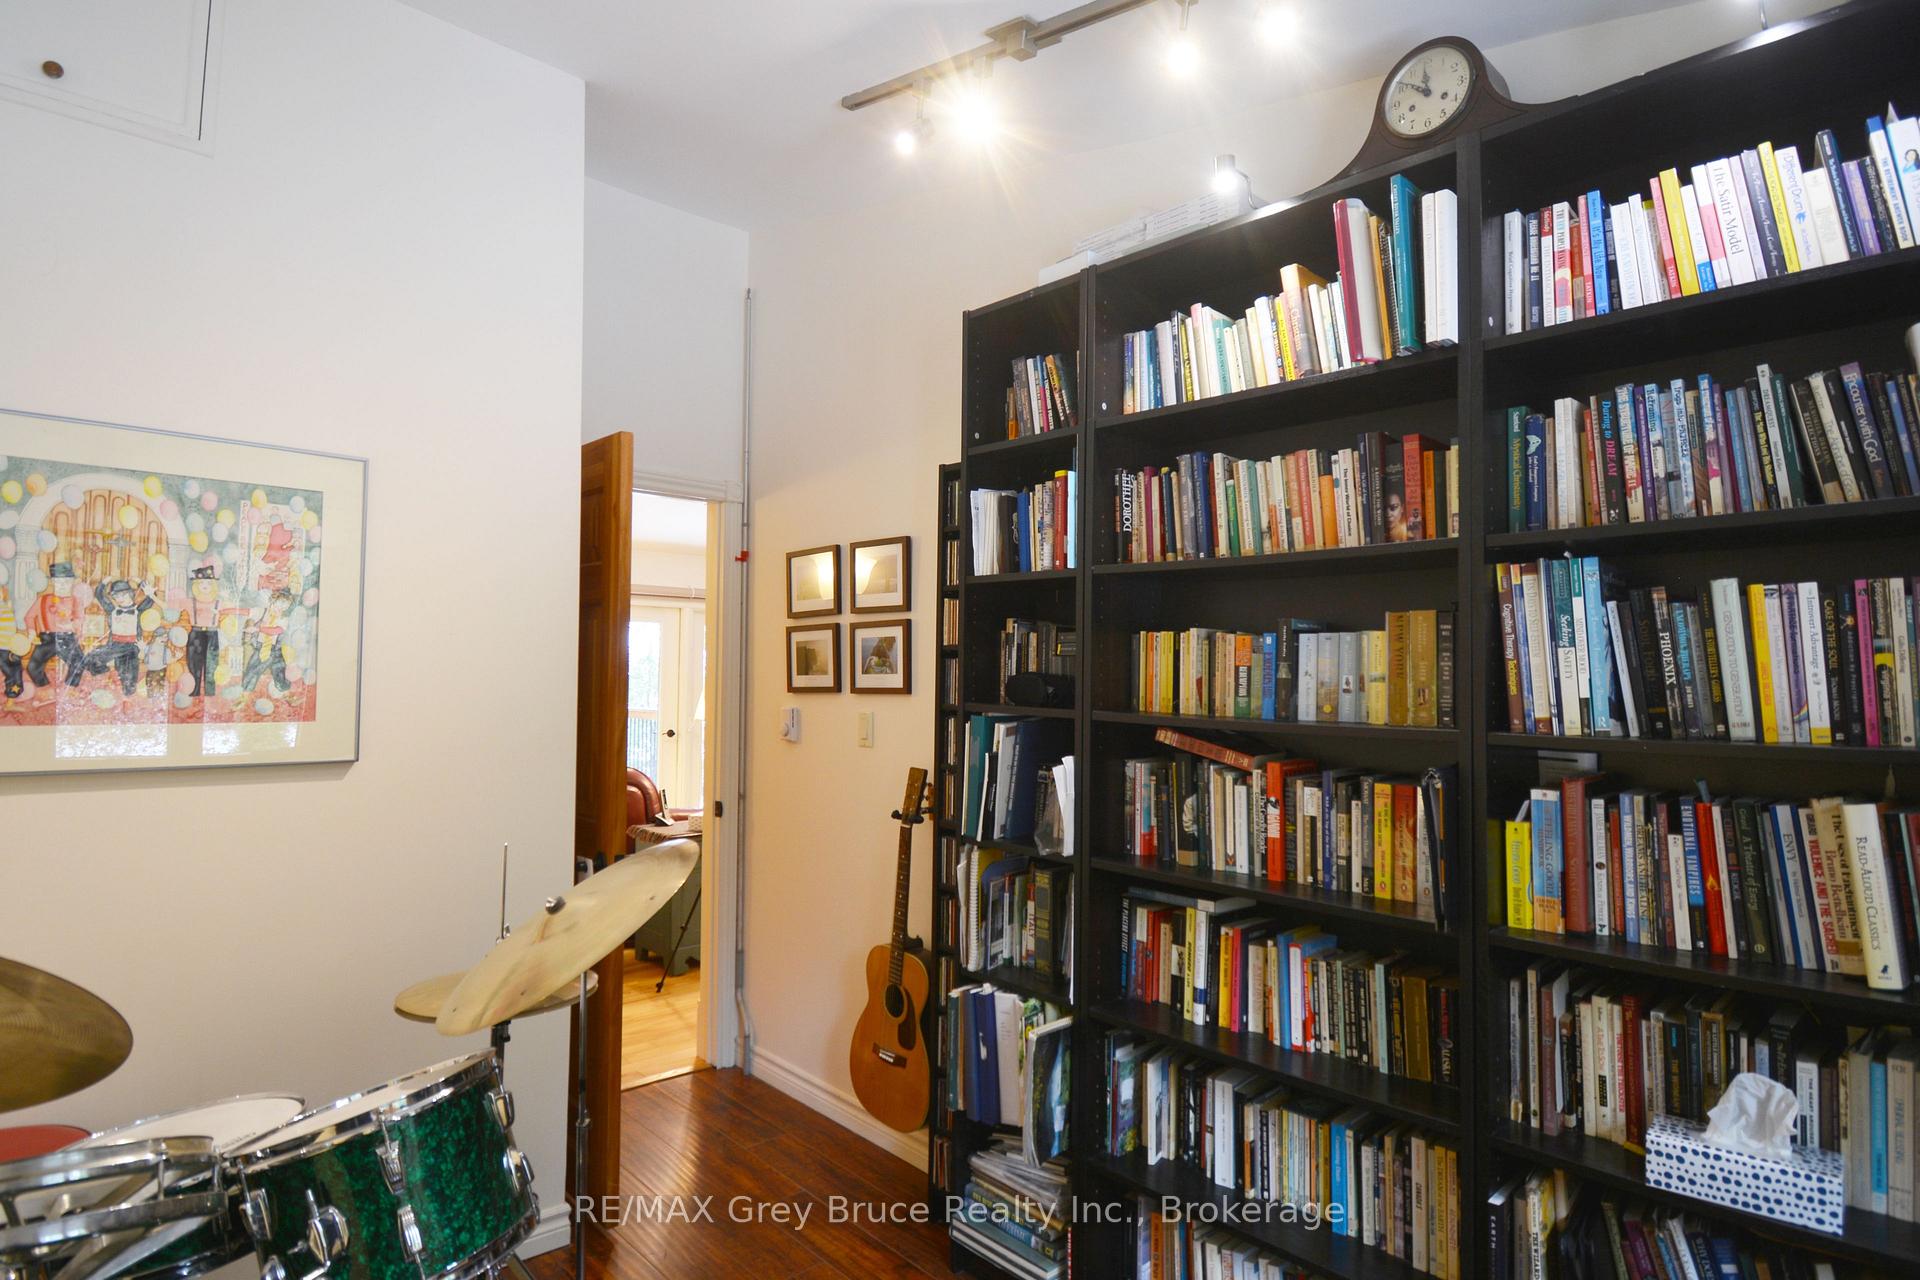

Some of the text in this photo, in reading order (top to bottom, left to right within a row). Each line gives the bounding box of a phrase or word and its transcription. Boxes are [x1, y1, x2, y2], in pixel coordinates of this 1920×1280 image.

[1712, 166, 1744, 255] The Satir Model
[1646, 389, 1658, 432] Reframing
[1674, 386, 1683, 405] Frogs
[1677, 408, 1685, 421] into
[1844, 373, 1882, 463] Encounter with God
[1512, 438, 1521, 469] Mystical
[1601, 401, 1617, 477] Daring to DREAM
[1617, 387, 1636, 478] THE STRUCTURE OF MAGIC
[1512, 470, 1521, 510] Christianity
[1503, 603, 1519, 695] Cognitive Therapy Techniques
[1559, 614, 1574, 680] Seeking SAFETY
[1659, 632, 1676, 685] PHOENIX
[1806, 597, 1821, 669] Introvert Advantage
[1824, 600, 1838, 669] CARE OF THE SOUL
[1681, 805, 1701, 895] EMOTIONAL VAMPIRES
[1783, 833, 1797, 863] ENVY
[1831, 815, 1844, 834] The
[1743, 845, 1757, 874] Theater
[1745, 877, 1760, 887] of
[1806, 814, 1838, 955] GIRARD VIOLENCE AND THE SACRED
[1824, 850, 1847, 938] Bruno Bettelheim
[1855, 837, 1881, 951] READ-ALOUD CLASSICS
